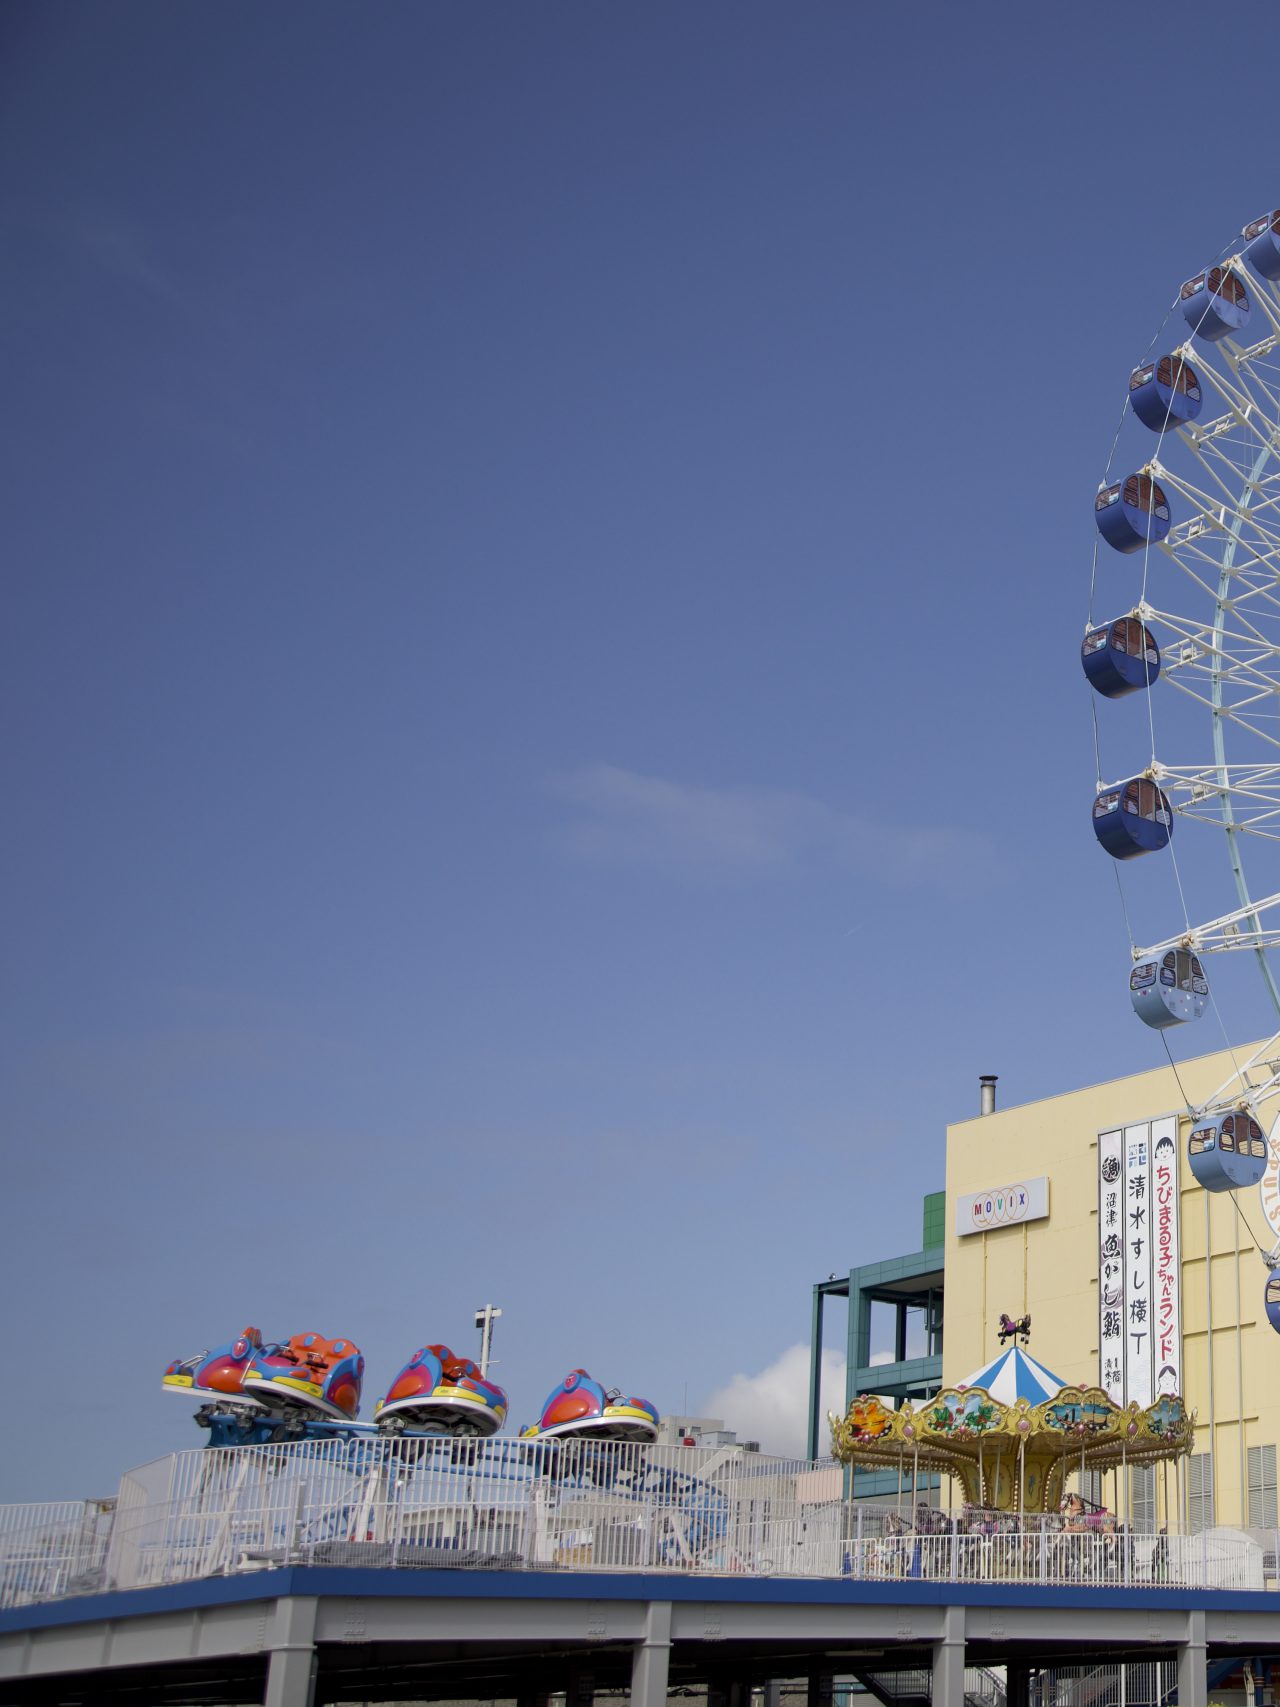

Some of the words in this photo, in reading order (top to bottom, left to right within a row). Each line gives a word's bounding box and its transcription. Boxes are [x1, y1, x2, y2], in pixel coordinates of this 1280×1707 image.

[974, 1193, 1025, 1216] MOVIX
[1129, 1174, 1147, 1355] 清水すし横丁
[1157, 1165, 1175, 1361] ちびまる子ちゃんランド
